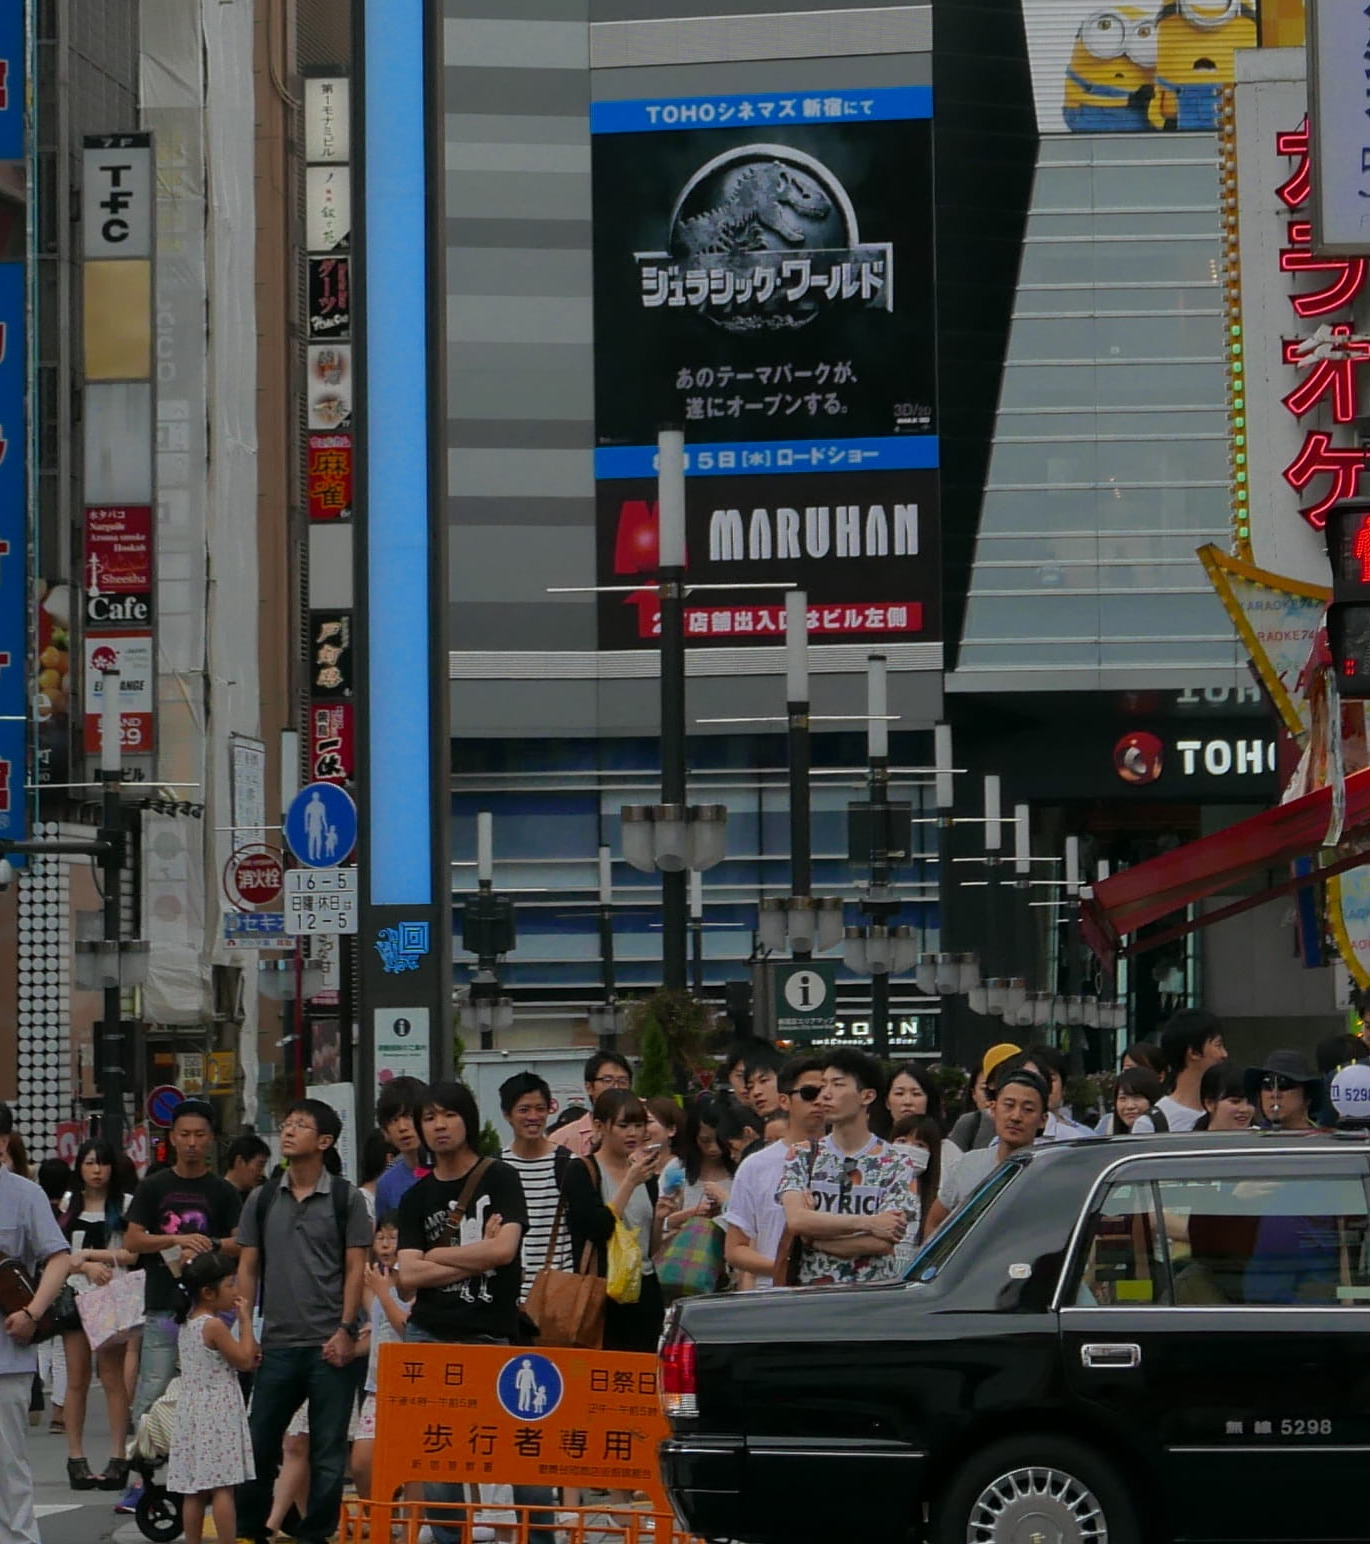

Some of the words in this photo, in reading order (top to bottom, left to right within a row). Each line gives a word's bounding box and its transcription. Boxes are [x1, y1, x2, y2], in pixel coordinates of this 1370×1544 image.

[646, 98, 797, 126] TOHOシネマズ
[802, 96, 875, 119] 新宿にて
[99, 165, 132, 243] TFC
[311, 450, 350, 507] 麻雀
[709, 502, 920, 562] MARUHAN
[101, 573, 147, 585] Sheesha
[88, 596, 149, 621] Cafe
[237, 869, 283, 889] 消火栓
[401, 1361, 465, 1387] 平日
[590, 1369, 659, 1396] 日祭日
[1280, 1419, 1332, 1436] 5298
[422, 1423, 633, 1462] 歩行者専用
